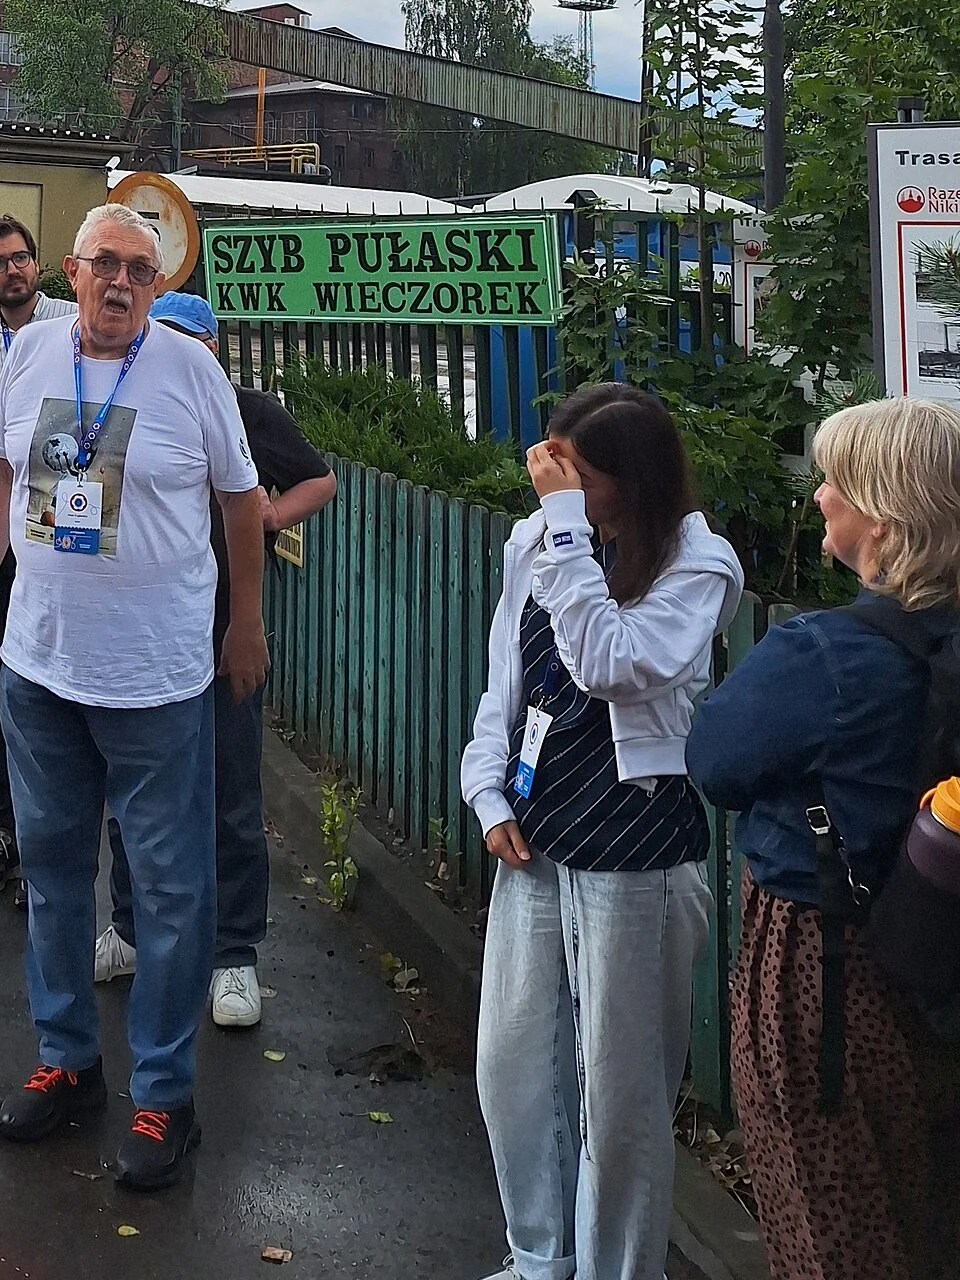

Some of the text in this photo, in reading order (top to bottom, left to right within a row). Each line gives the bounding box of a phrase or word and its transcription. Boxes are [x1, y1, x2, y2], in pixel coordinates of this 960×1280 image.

[211, 228, 539, 275] SZYB PUŁASKI
[215, 281, 289, 312] KWK
